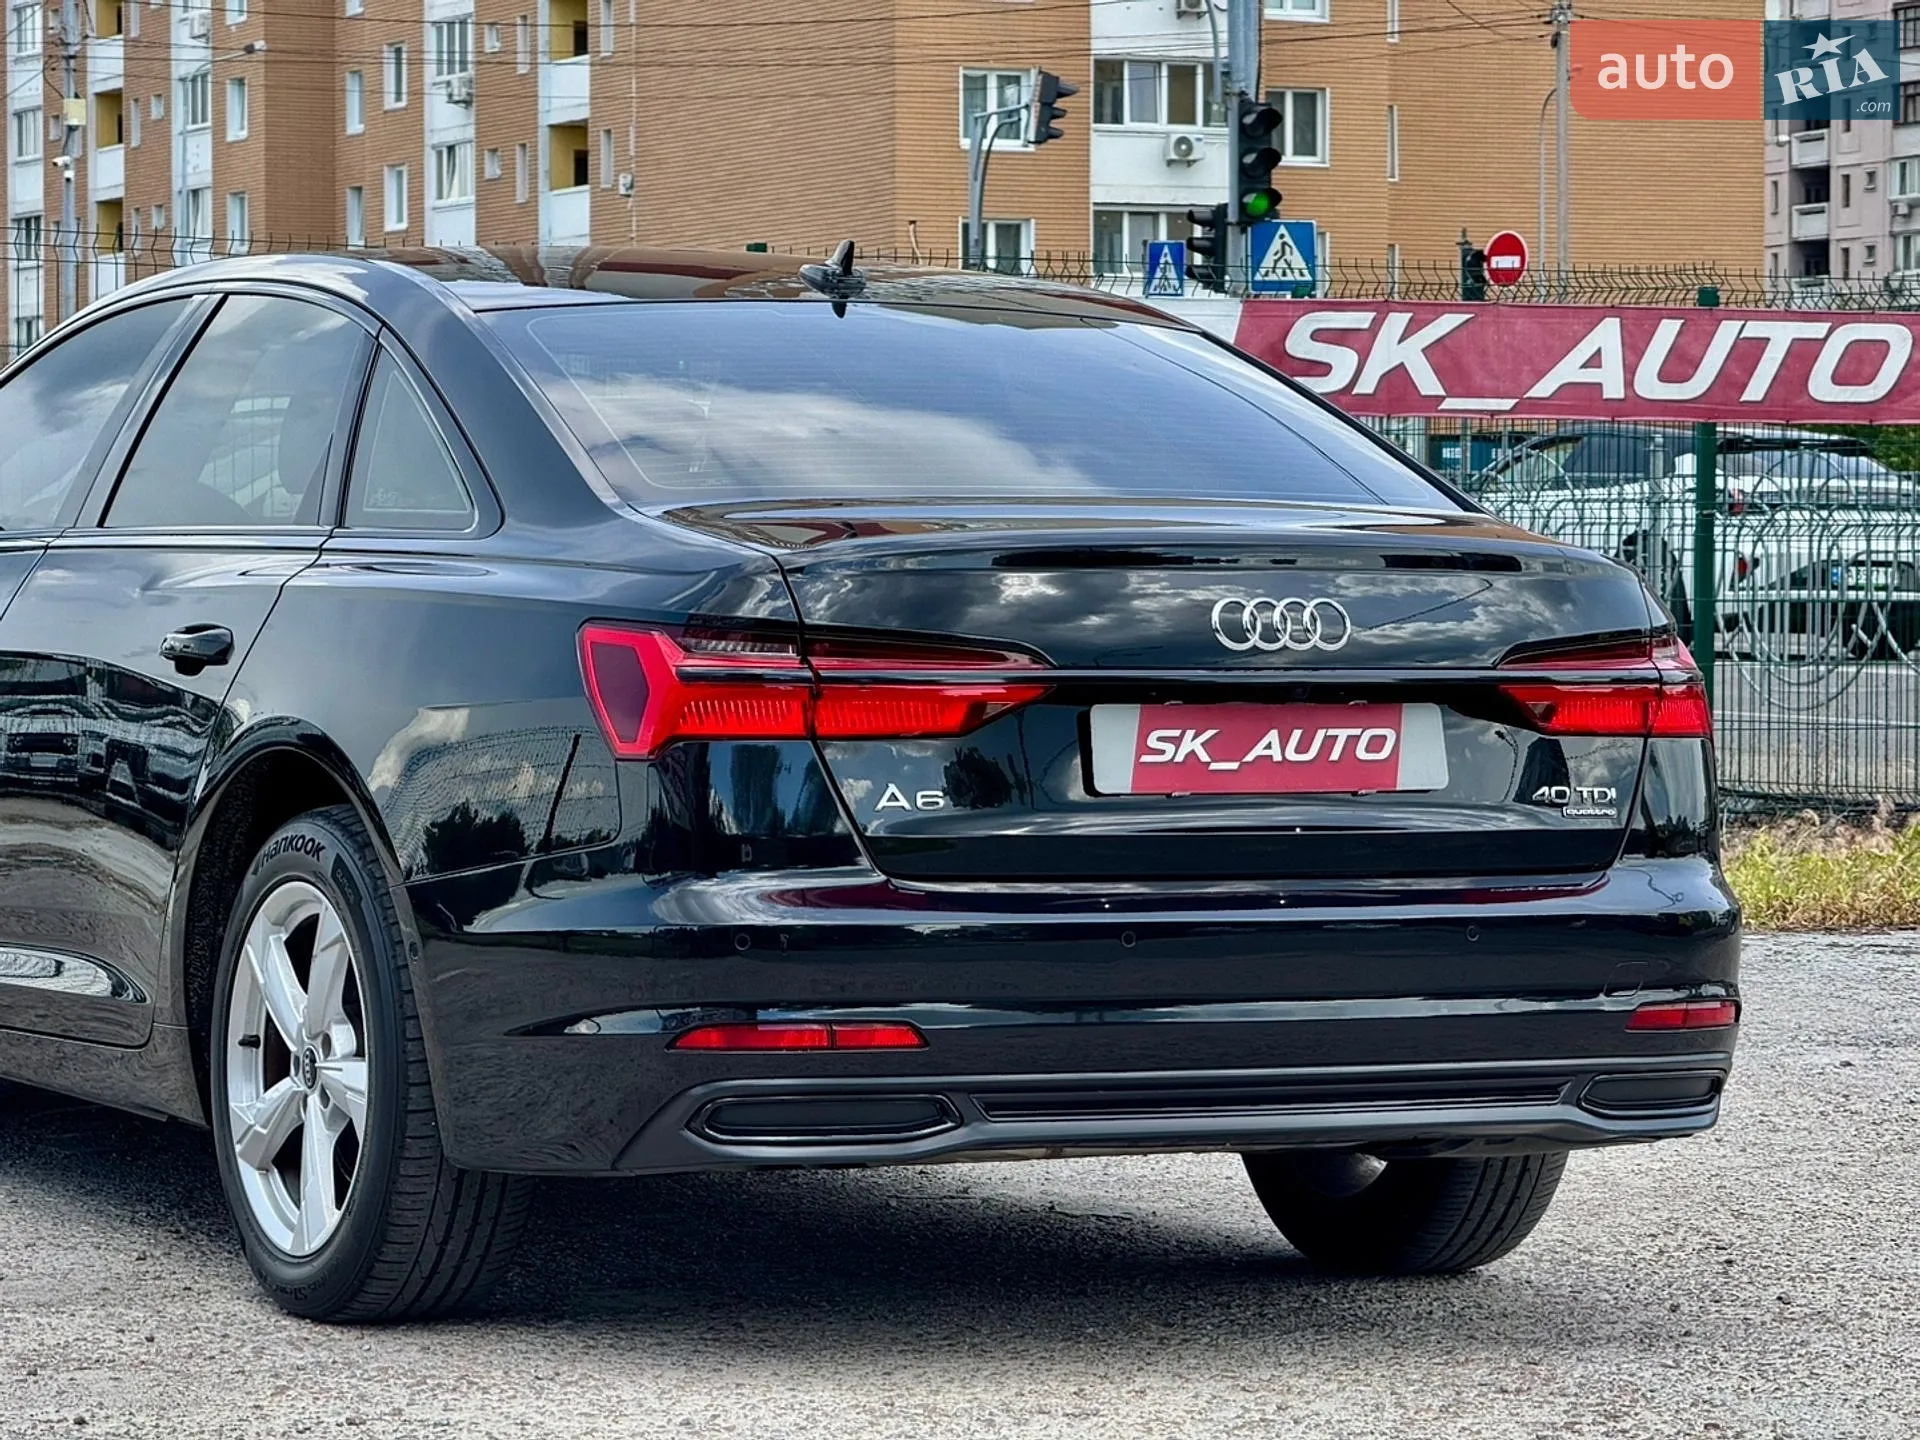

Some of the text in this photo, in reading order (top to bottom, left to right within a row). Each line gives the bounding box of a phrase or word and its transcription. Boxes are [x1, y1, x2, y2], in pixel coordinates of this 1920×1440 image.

[1284, 311, 1914, 412] SK_AUTO
[1138, 727, 1396, 771] SK_AUTO
[874, 782, 945, 812] A6
[1532, 786, 1617, 804] 40 TDI
[1566, 808, 1617, 818] quattro
